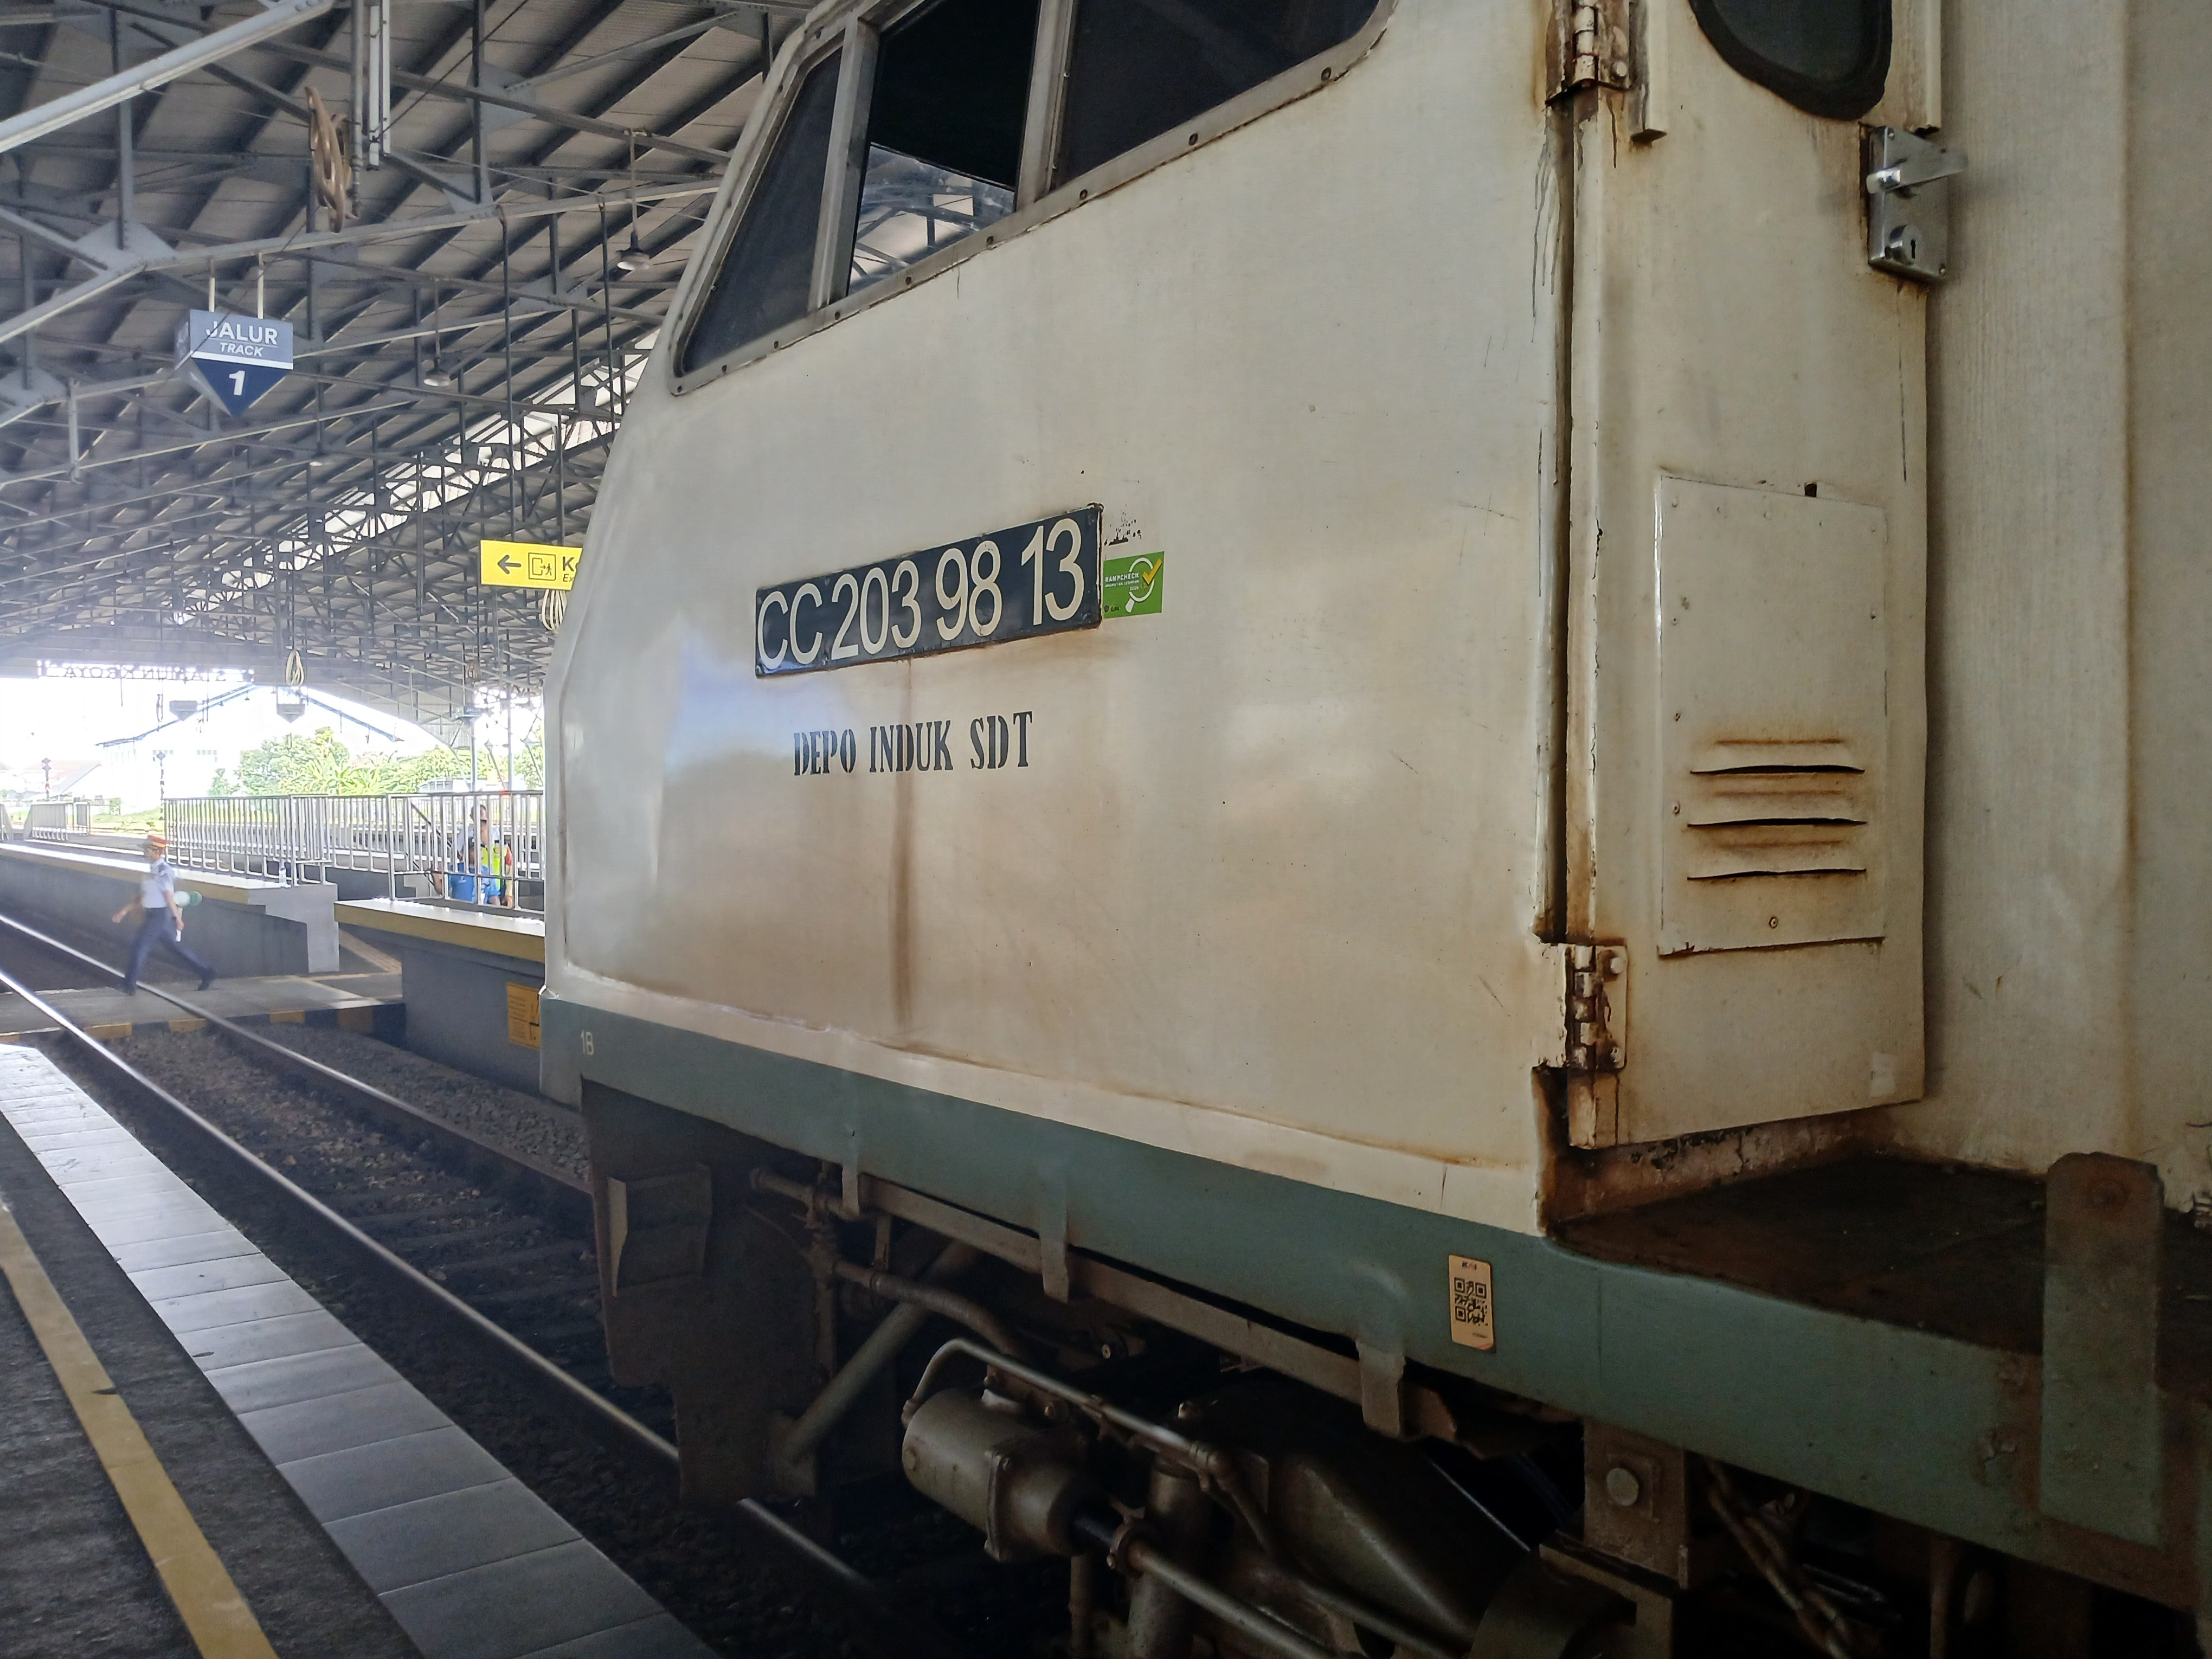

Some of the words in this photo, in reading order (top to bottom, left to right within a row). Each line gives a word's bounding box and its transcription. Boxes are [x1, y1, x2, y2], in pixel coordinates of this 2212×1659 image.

[205, 320, 278, 345] JALUR
[220, 342, 263, 357] TRACK
[228, 370, 245, 396] 1
[562, 556, 577, 572] K
[1105, 573, 1139, 582] RAMPCHECK
[759, 582, 822, 670] CC
[831, 560, 921, 660] 203
[935, 540, 1001, 641] 98
[1021, 517, 1084, 626] 13
[793, 728, 857, 776] DEPO
[869, 719, 954, 773] INDUK
[970, 711, 1033, 770] SDT
[581, 1030, 594, 1056] 1B
